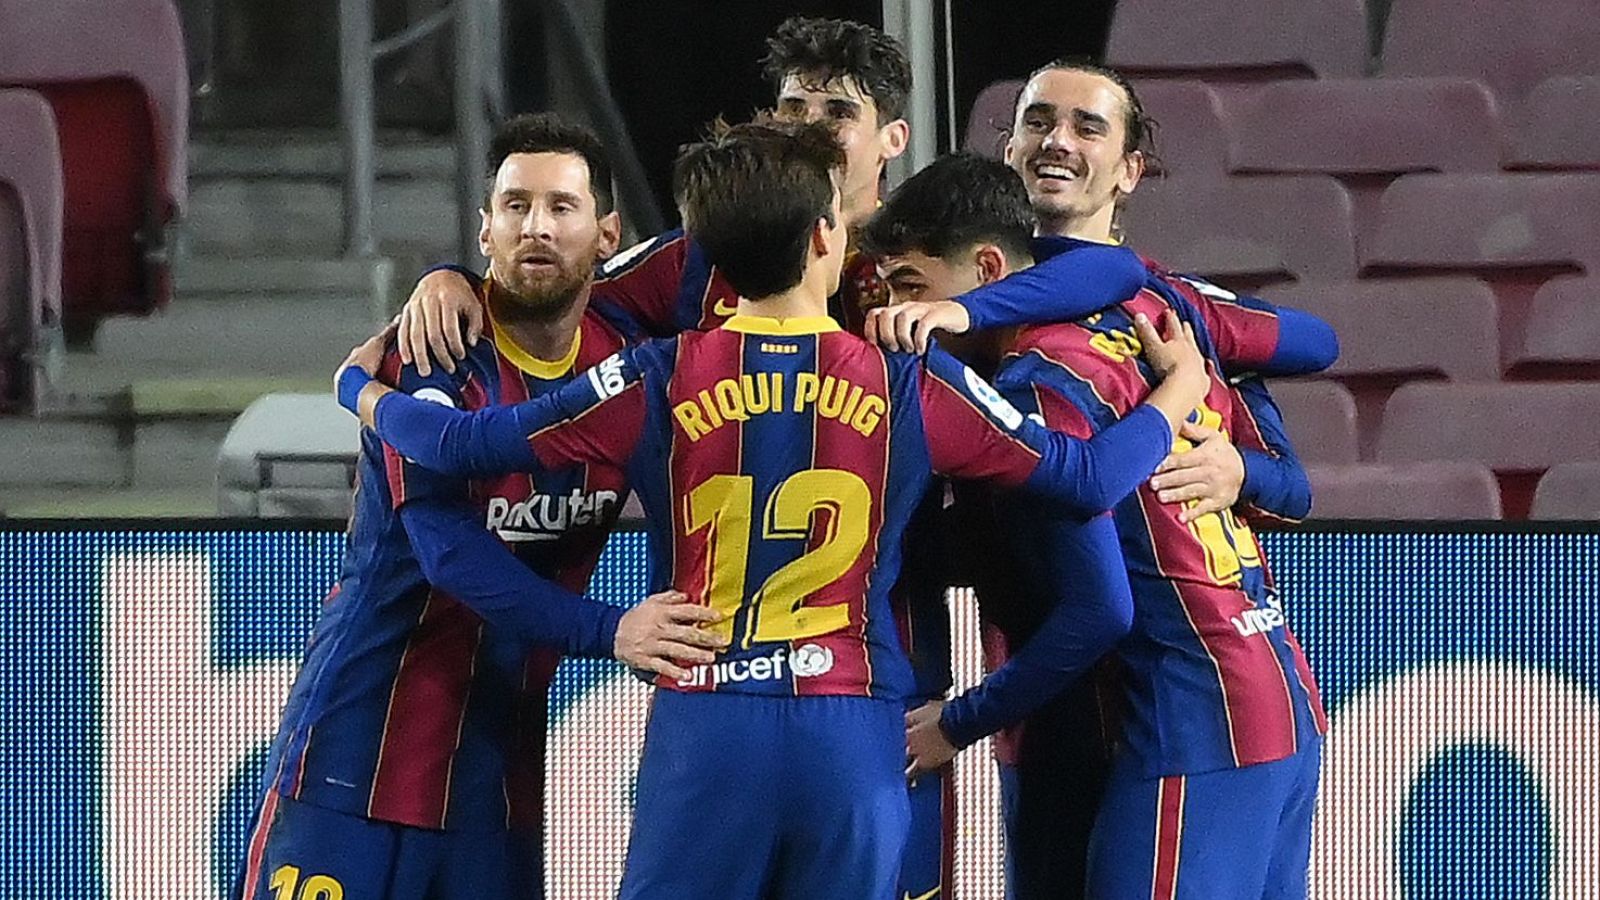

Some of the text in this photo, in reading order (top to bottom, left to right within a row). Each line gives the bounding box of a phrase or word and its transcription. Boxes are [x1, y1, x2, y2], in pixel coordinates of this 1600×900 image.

[673, 373, 784, 442] RIQUI
[793, 373, 886, 438] PUIG
[684, 468, 872, 653] 12
